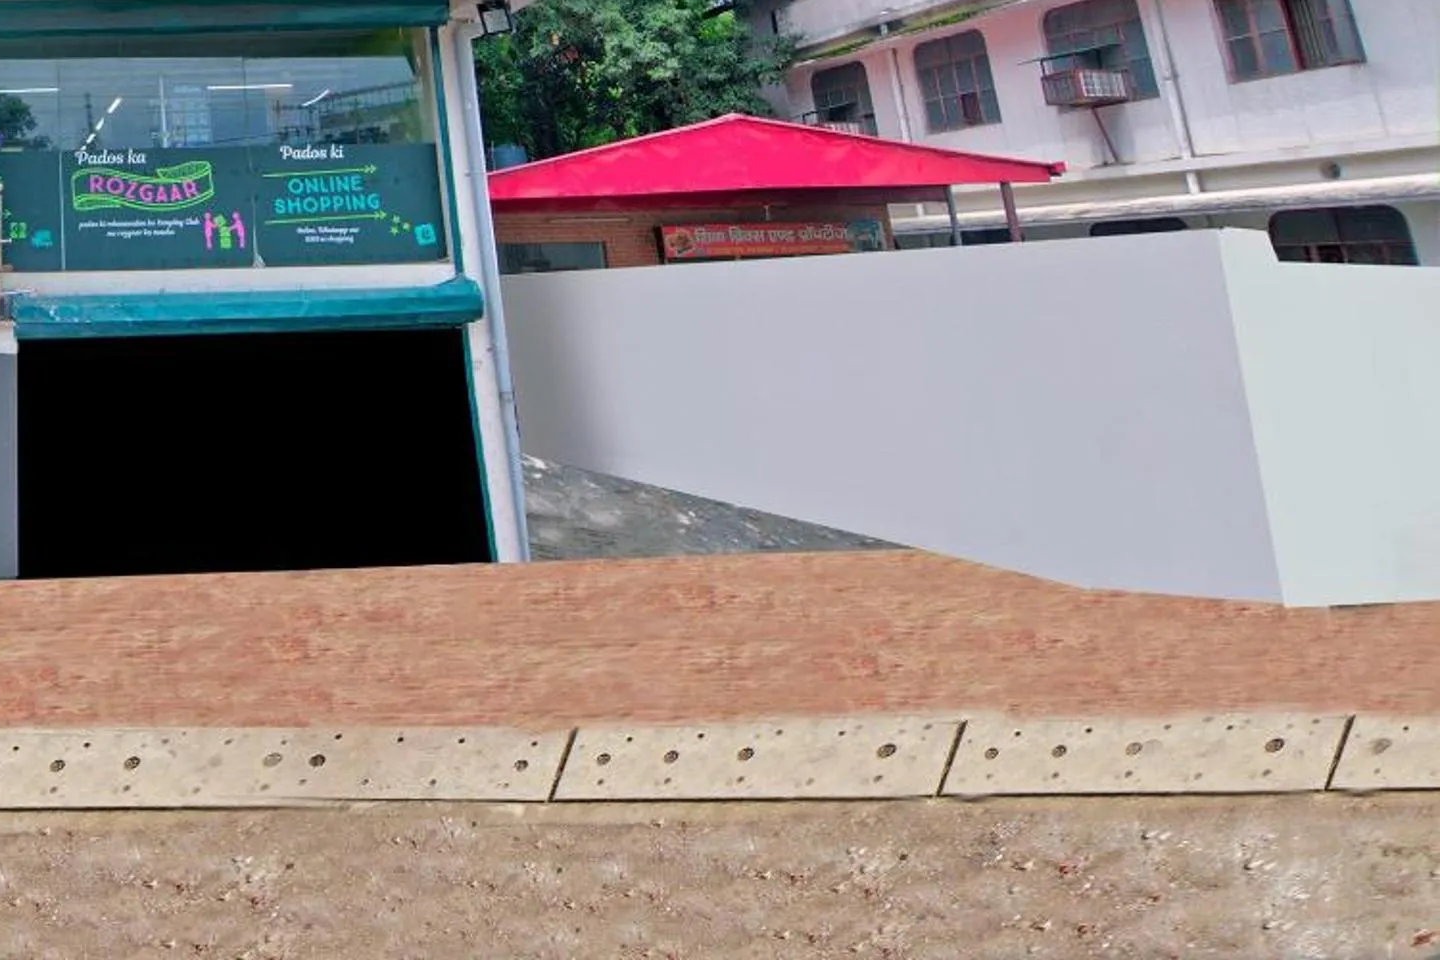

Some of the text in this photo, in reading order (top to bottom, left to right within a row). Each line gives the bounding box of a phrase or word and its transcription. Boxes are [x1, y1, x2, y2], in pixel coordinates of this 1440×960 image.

[74, 147, 147, 165] Pados ka
[279, 143, 345, 160] Pados ki
[88, 174, 198, 202] ROZGAAR
[287, 175, 364, 194] ONLINE
[274, 193, 381, 215] SHOPPING
